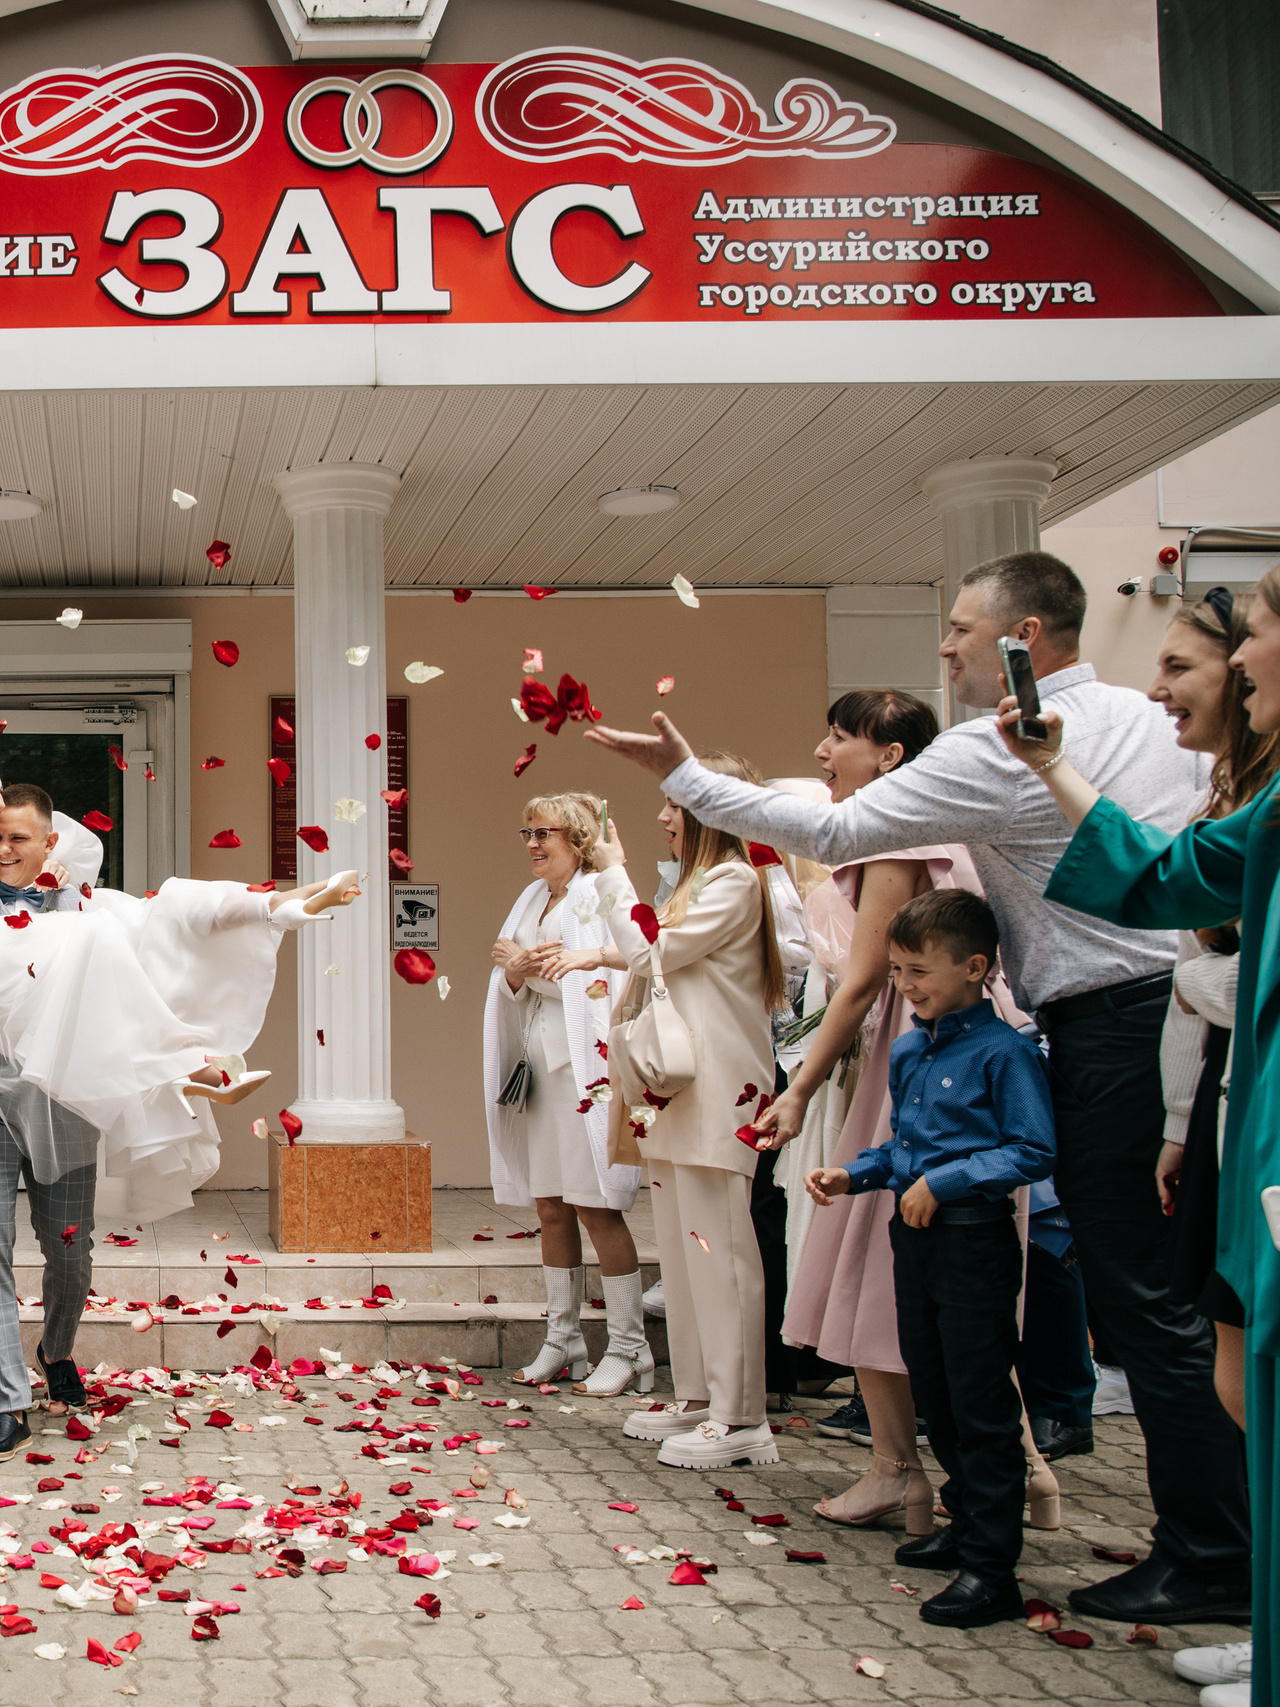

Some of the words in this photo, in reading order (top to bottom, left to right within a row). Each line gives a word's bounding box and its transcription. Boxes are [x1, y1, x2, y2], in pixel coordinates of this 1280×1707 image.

[694, 191, 1040, 226] Администрация
[98, 182, 653, 317] ЗАГС
[694, 230, 990, 272] Уссурийского
[698, 282, 938, 315] городского
[950, 281, 1097, 313] округа
